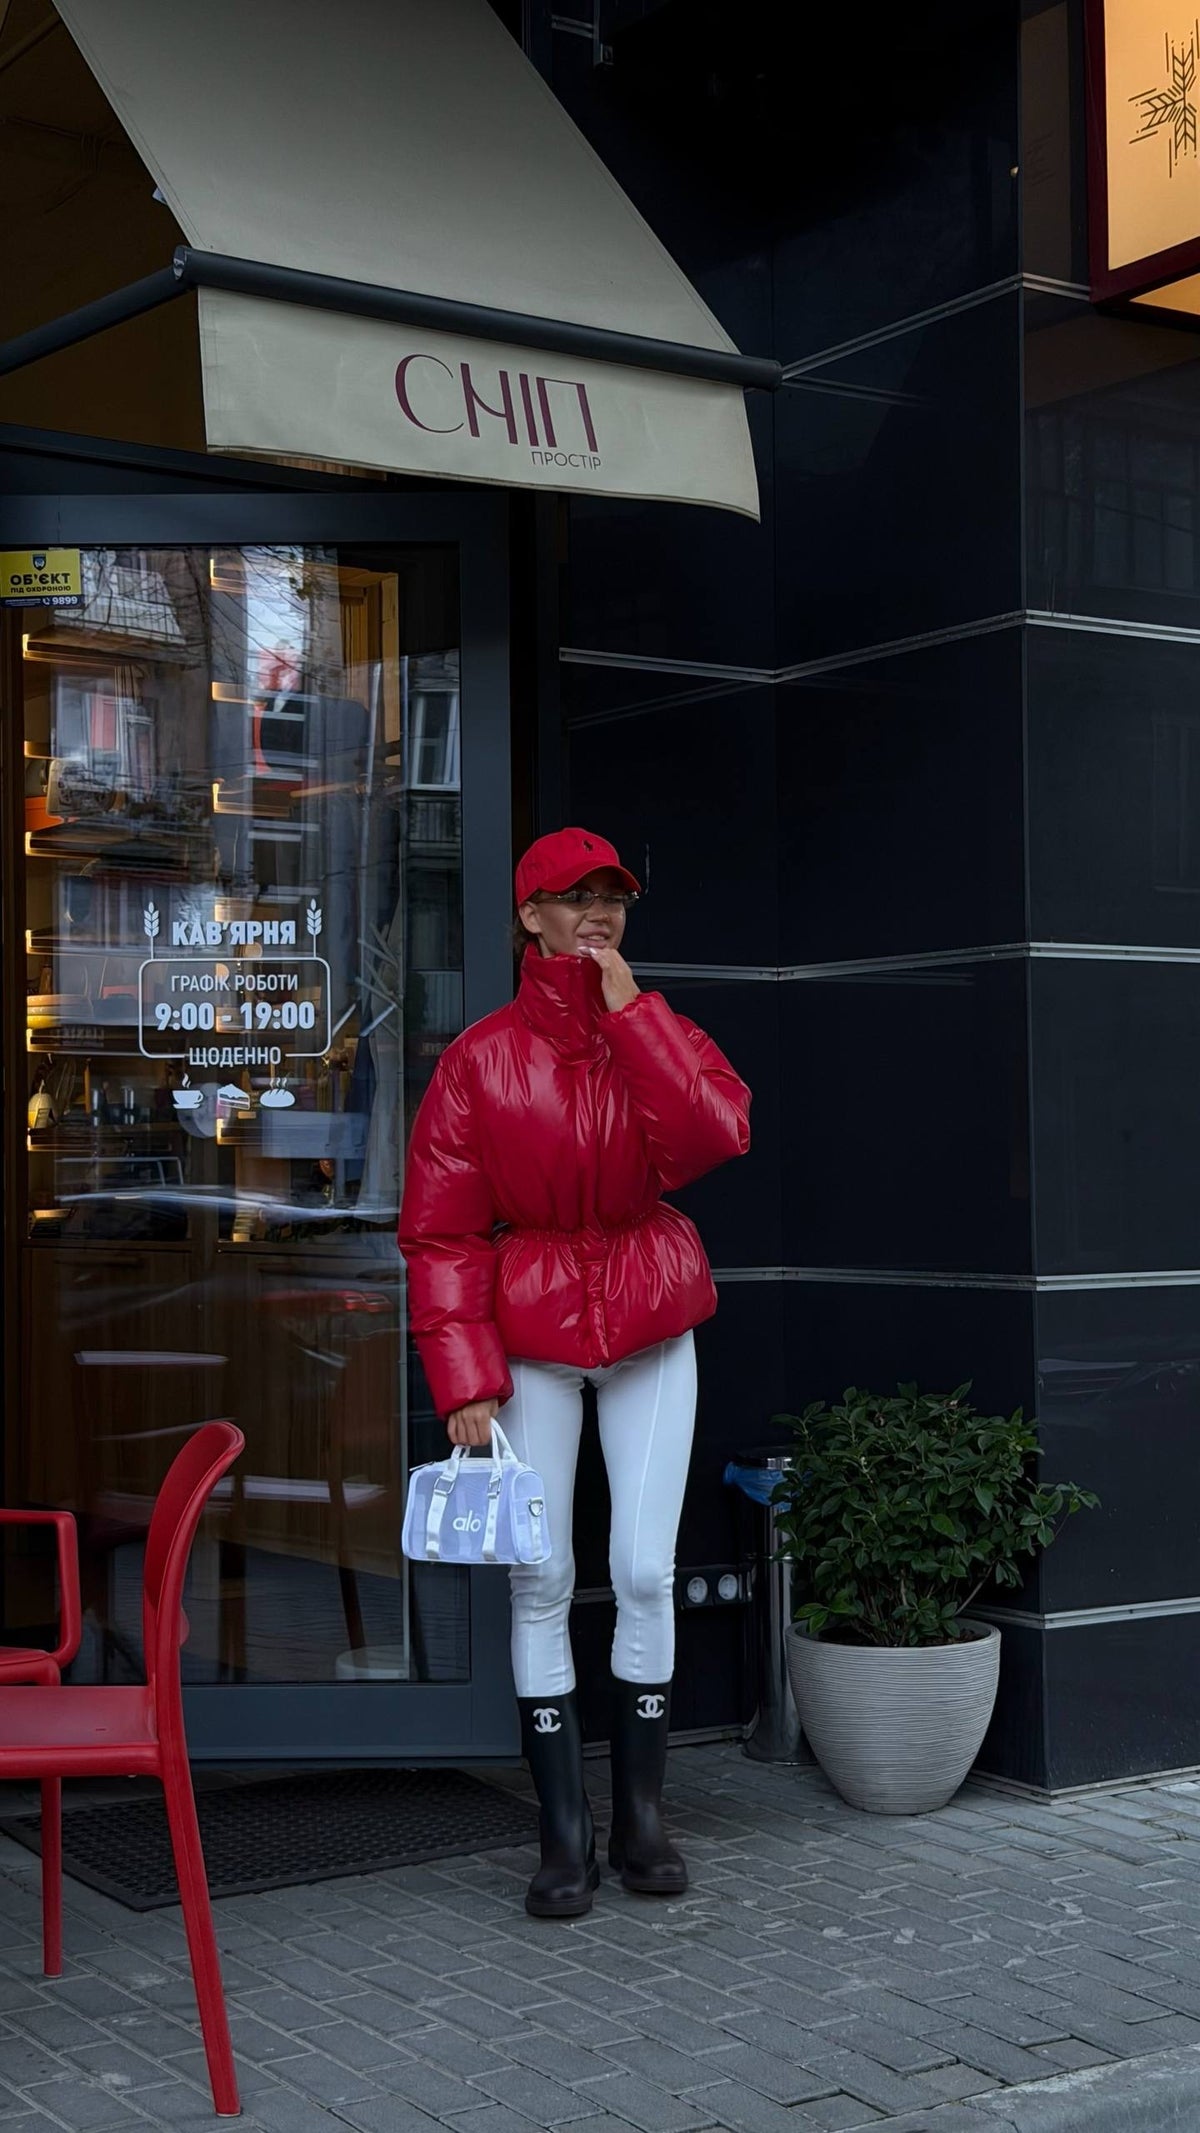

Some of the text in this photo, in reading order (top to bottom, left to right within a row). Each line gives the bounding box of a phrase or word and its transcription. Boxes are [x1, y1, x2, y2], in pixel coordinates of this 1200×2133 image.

[531, 451, 601, 471] ПРОСТІР
[26, 585, 71, 593] ОХОРОНОЮ
[52, 596, 78, 605] 9899
[171, 974, 298, 992] ГРАФІК РОБОТИ
[155, 1002, 214, 1031] 9:00
[240, 1001, 315, 1030] 19:00
[189, 1046, 281, 1067] ЩОДЕННО
[452, 1510, 482, 1532] alo
